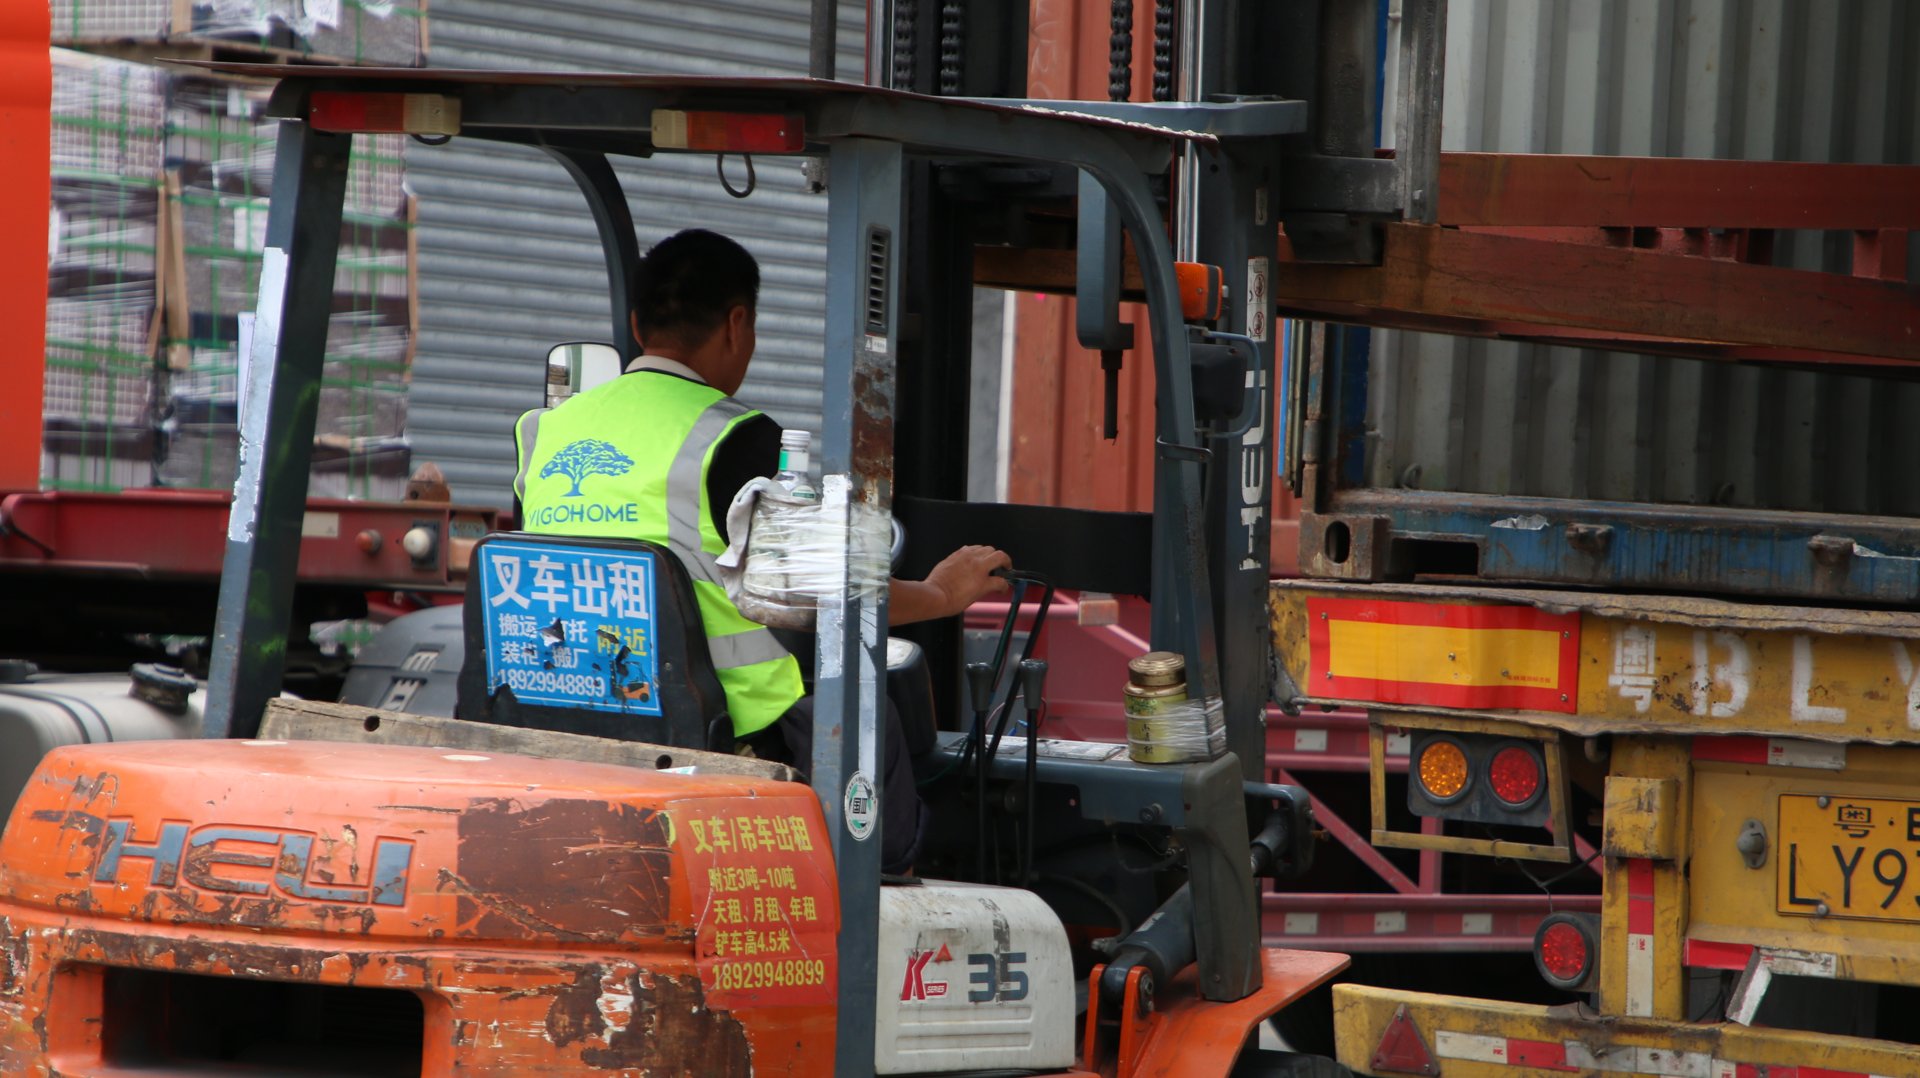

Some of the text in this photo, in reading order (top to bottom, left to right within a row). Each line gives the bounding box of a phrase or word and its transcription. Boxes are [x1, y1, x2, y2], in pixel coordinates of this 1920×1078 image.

[490, 554, 649, 620] 叉车出租
[498, 613, 537, 639] 搬运
[498, 668, 605, 698] 18929948899
[688, 815, 813, 854] 叉车/吊车出租
[92, 815, 416, 907] HELI
[1789, 843, 1920, 909] LY9
[708, 867, 798, 892] 附近3吨-10吨
[713, 896, 818, 925] 天租、月租、年租
[715, 928, 790, 957] 铲车高4.5米
[712, 960, 825, 991] 18929948899
[900, 951, 934, 1001] K
[967, 952, 1029, 1003] 35
